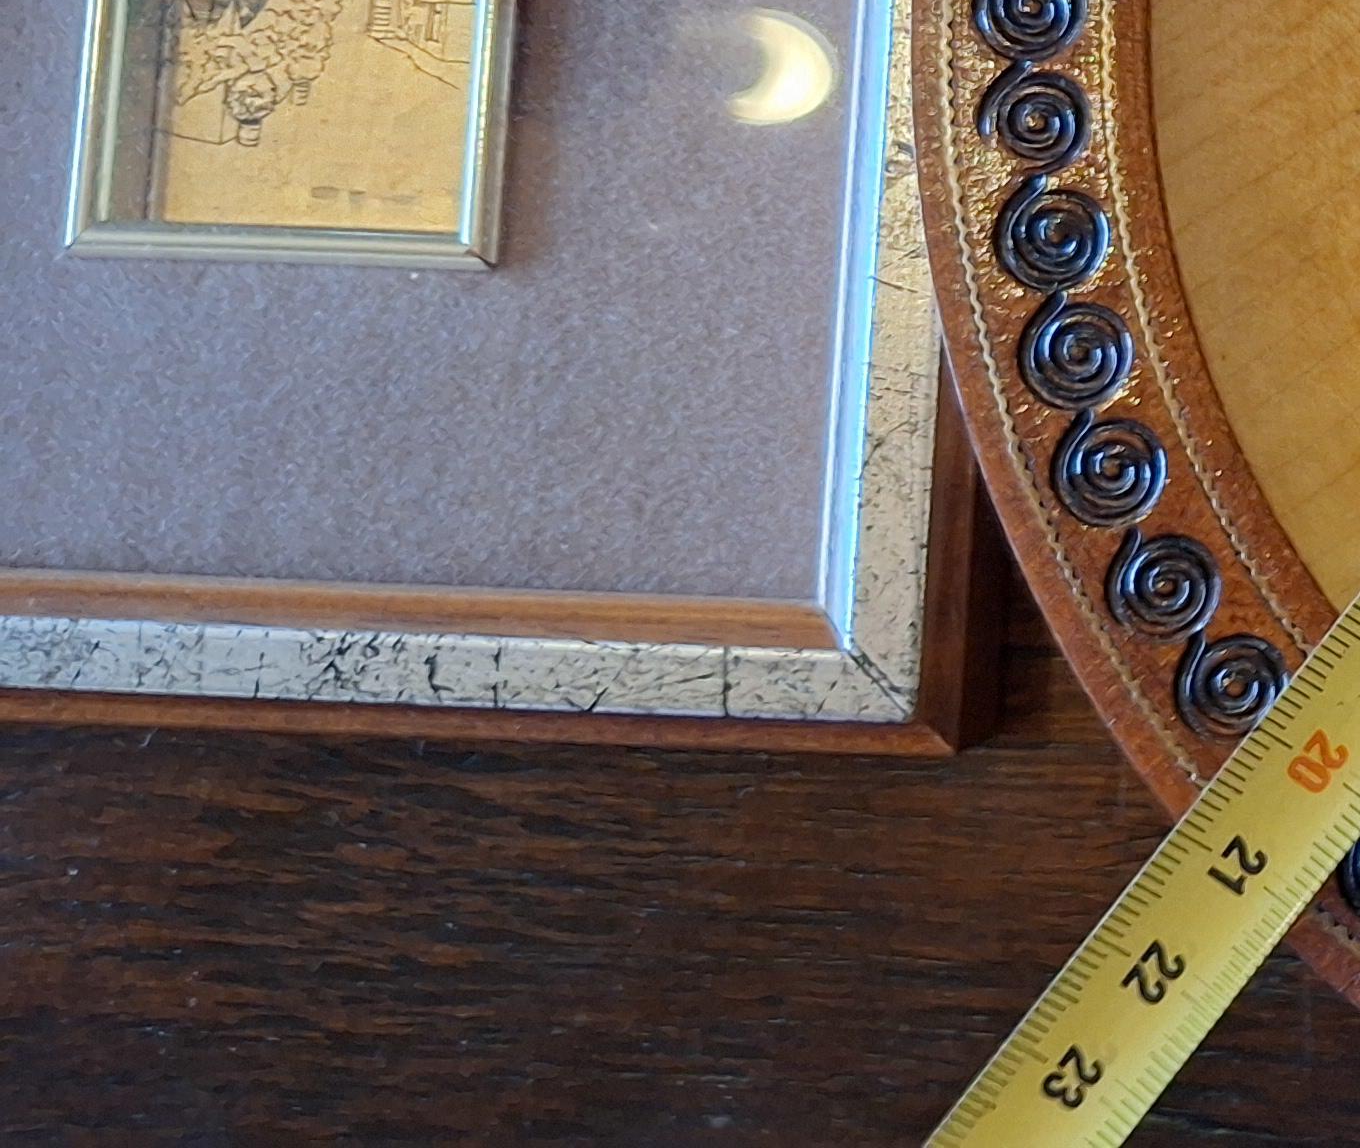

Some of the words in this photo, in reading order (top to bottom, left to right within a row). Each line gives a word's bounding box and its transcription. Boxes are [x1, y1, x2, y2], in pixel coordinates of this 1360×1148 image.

[1288, 729, 1349, 793] 20
[1207, 835, 1268, 896] 21
[1120, 939, 1185, 1005] 22
[1042, 1044, 1104, 1110] 23
